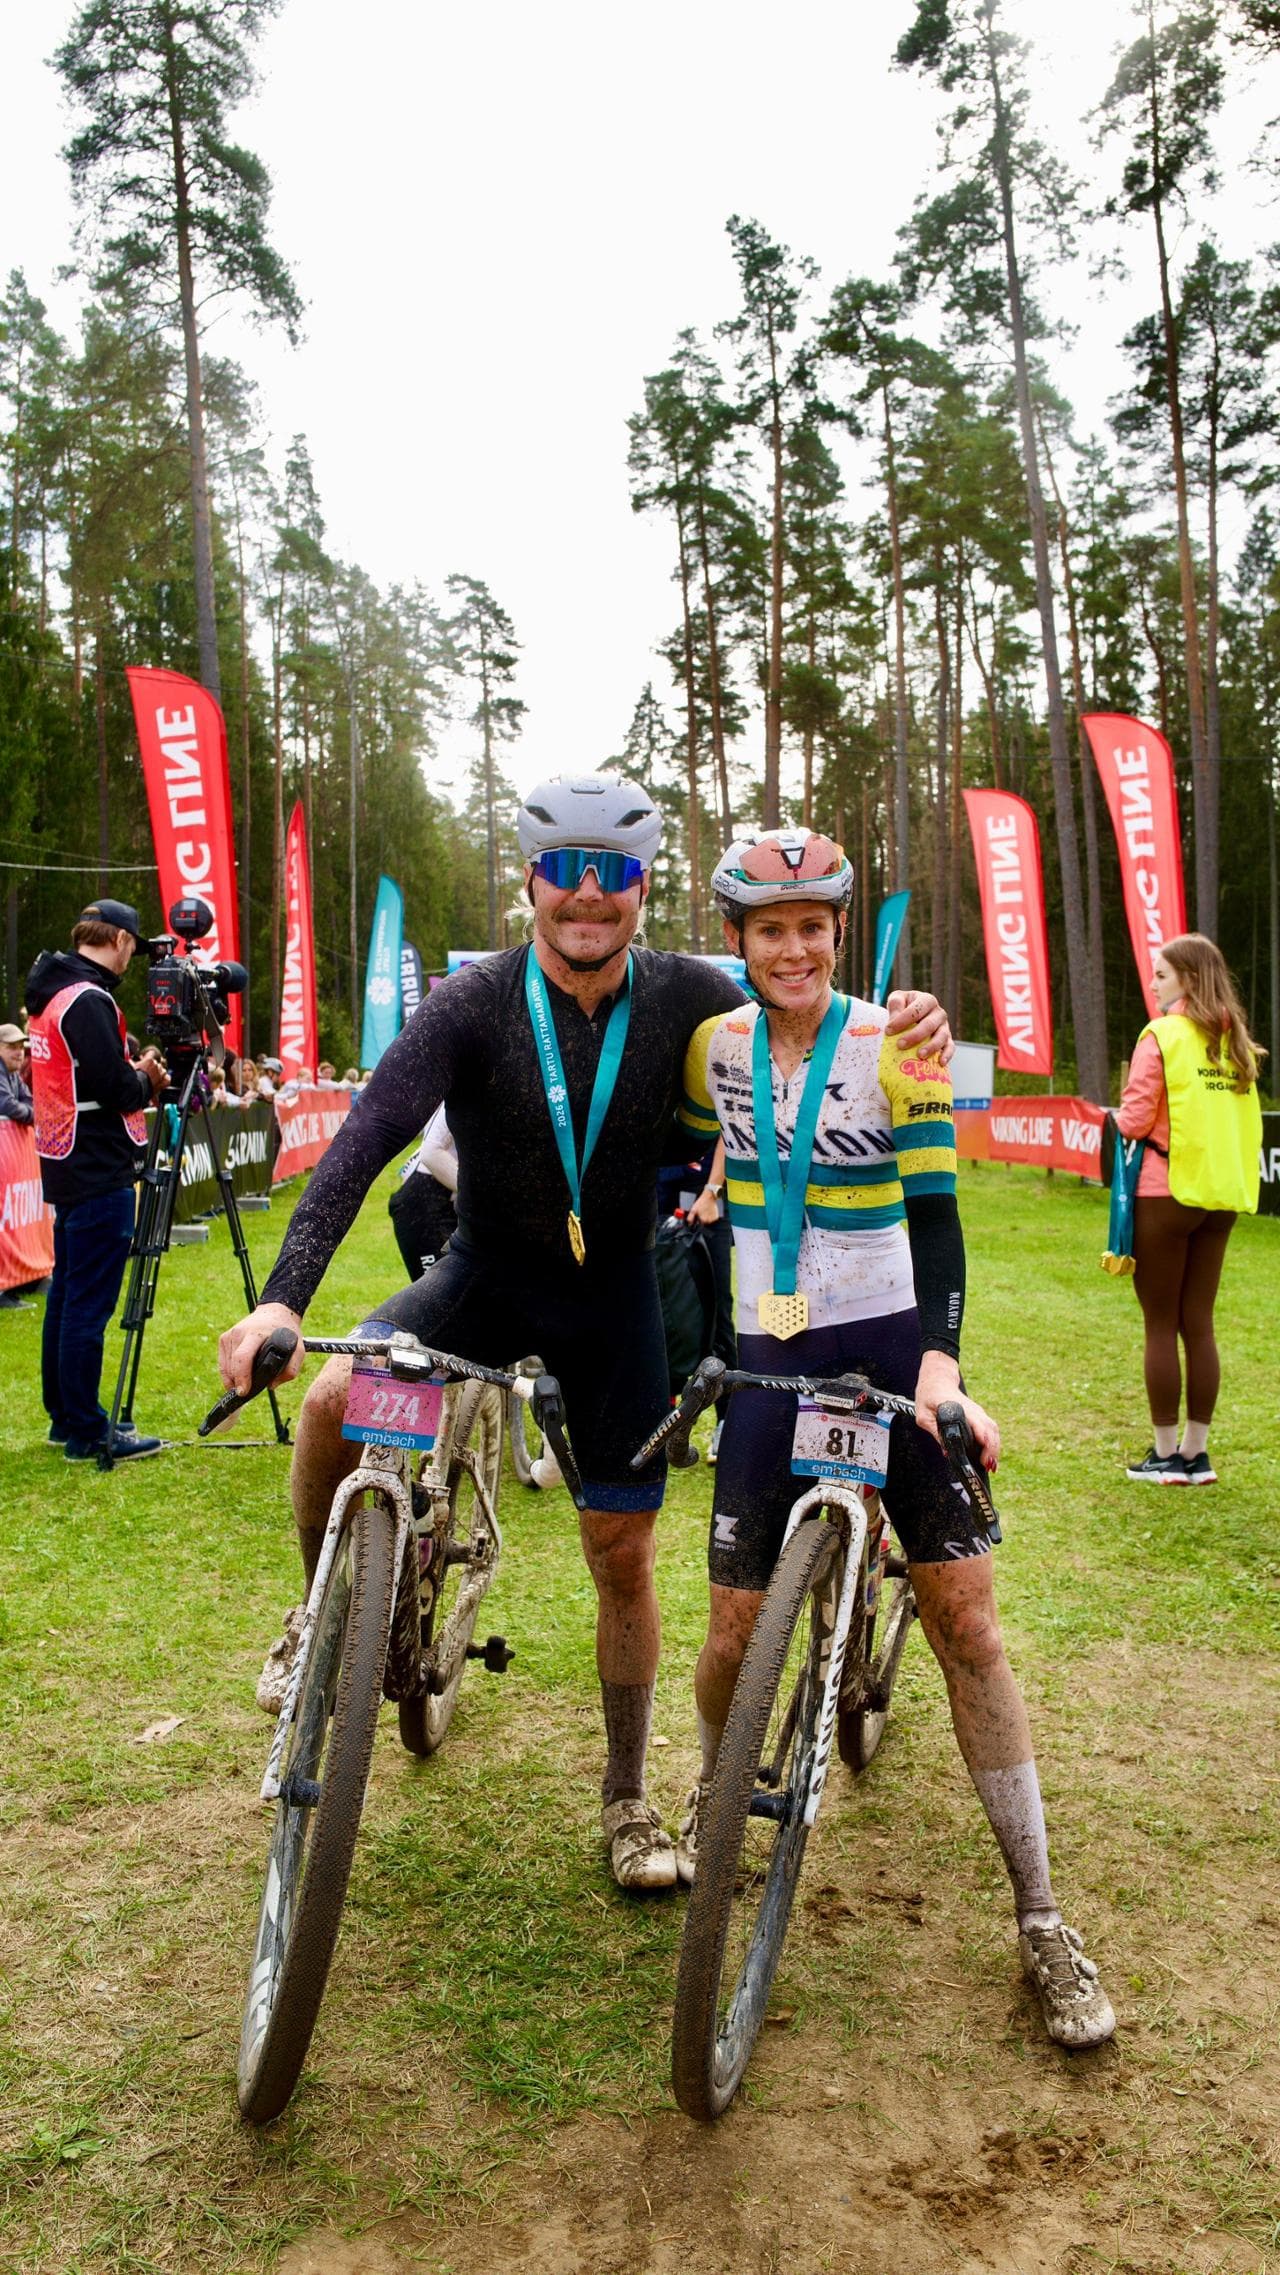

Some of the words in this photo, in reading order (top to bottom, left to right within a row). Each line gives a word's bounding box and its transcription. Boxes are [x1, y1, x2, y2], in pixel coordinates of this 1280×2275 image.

[531, 979, 552, 1051] RATTAMARATON
[548, 1052, 559, 1083] TARTU
[908, 1101, 953, 1118] SRA
[991, 1116, 1028, 1145] VIKING
[1029, 1116, 1054, 1147] LINE
[948, 1291, 960, 1329] CANYON
[761, 1380, 816, 1392] CANYON
[370, 1390, 420, 1426] 274
[874, 1395, 916, 1418] CANYO
[362, 1431, 415, 1448] embach
[826, 1427, 857, 1457] 81
[812, 1463, 866, 1480] embach
